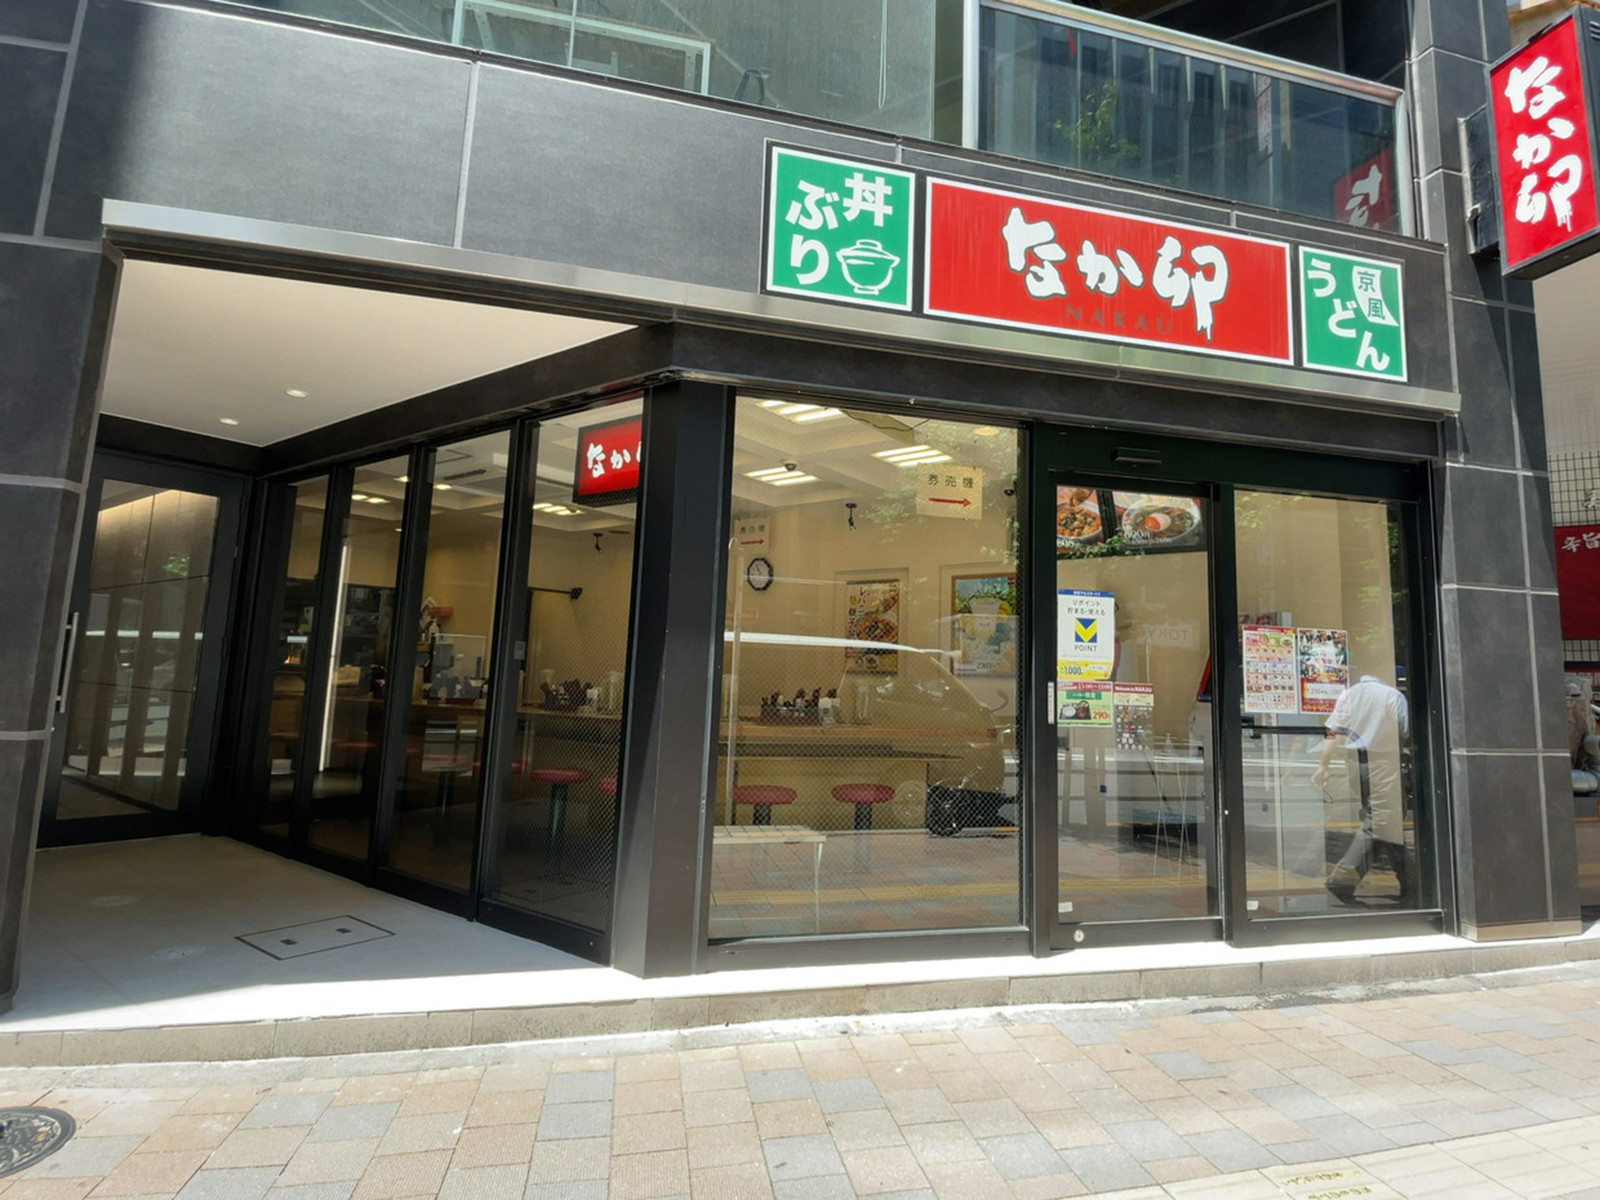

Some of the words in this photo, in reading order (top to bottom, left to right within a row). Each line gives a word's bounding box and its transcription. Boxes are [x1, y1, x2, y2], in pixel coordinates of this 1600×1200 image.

[1505, 56, 1582, 232] なか卯
[1002, 206, 1229, 343] なか卯
[1356, 270, 1386, 321] 京風
[1065, 303, 1172, 335] NAKAU
[1307, 258, 1391, 372] うどん
[586, 441, 642, 478] なか
[928, 473, 974, 489] 券売機
[1074, 644, 1098, 652] POINT
